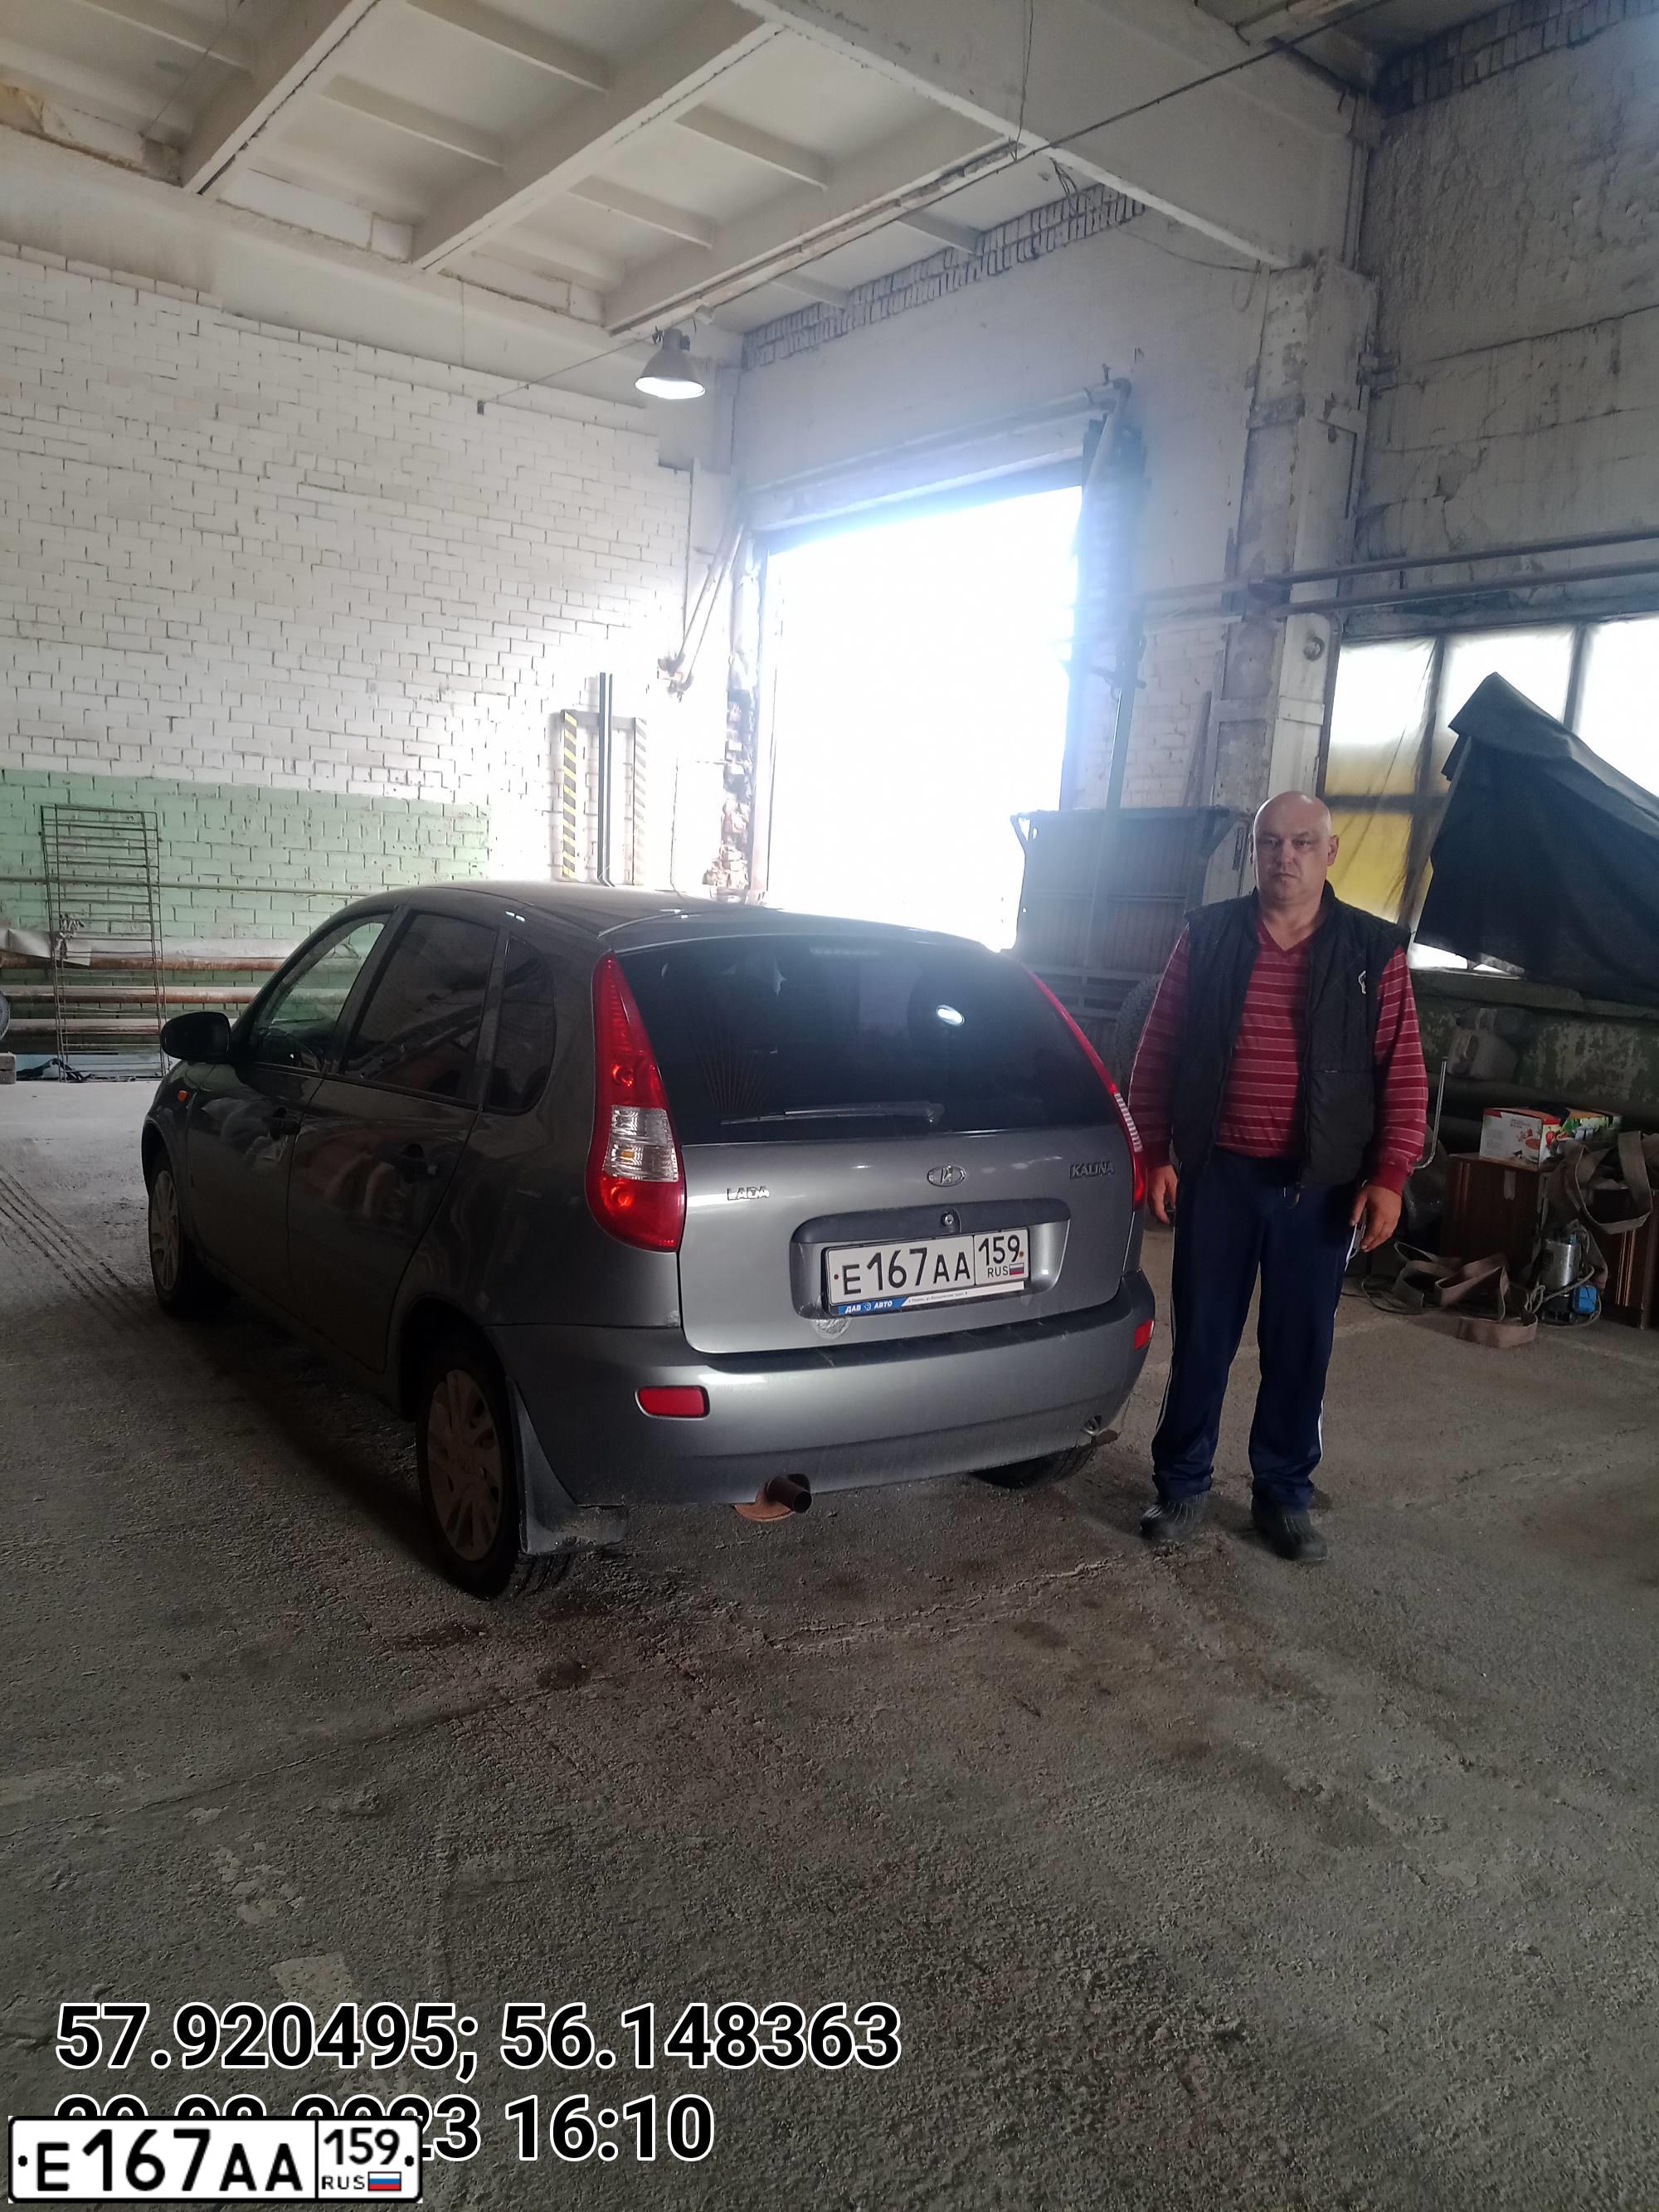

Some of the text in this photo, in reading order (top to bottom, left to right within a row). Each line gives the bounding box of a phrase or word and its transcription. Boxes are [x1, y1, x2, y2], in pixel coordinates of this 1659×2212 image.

[1069, 1161, 1115, 1178] KALINA
[727, 1186, 770, 1201] LADA
[978, 1235, 1020, 1266] 159
[987, 1265, 1009, 1278] RUS
[844, 1300, 893, 1314] ДАВ АВТО
